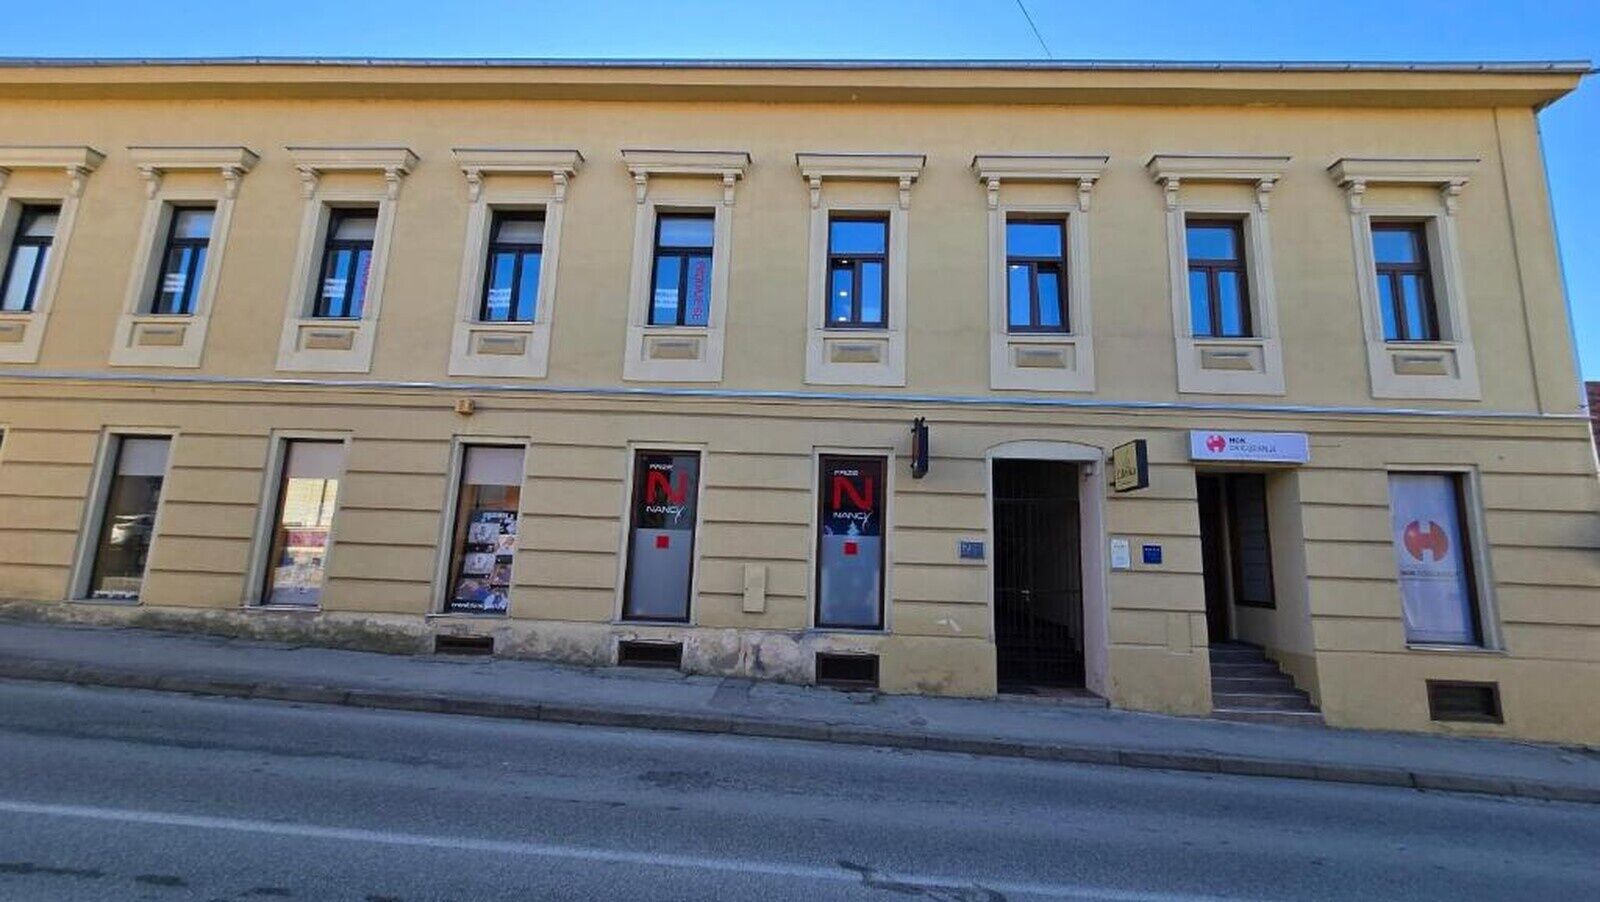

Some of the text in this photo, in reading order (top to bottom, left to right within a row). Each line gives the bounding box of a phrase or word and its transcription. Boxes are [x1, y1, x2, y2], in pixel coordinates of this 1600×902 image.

[646, 470, 688, 503] N
[832, 476, 873, 510] N
[646, 503, 685, 524] NANCY
[833, 511, 872, 532] NANCY
